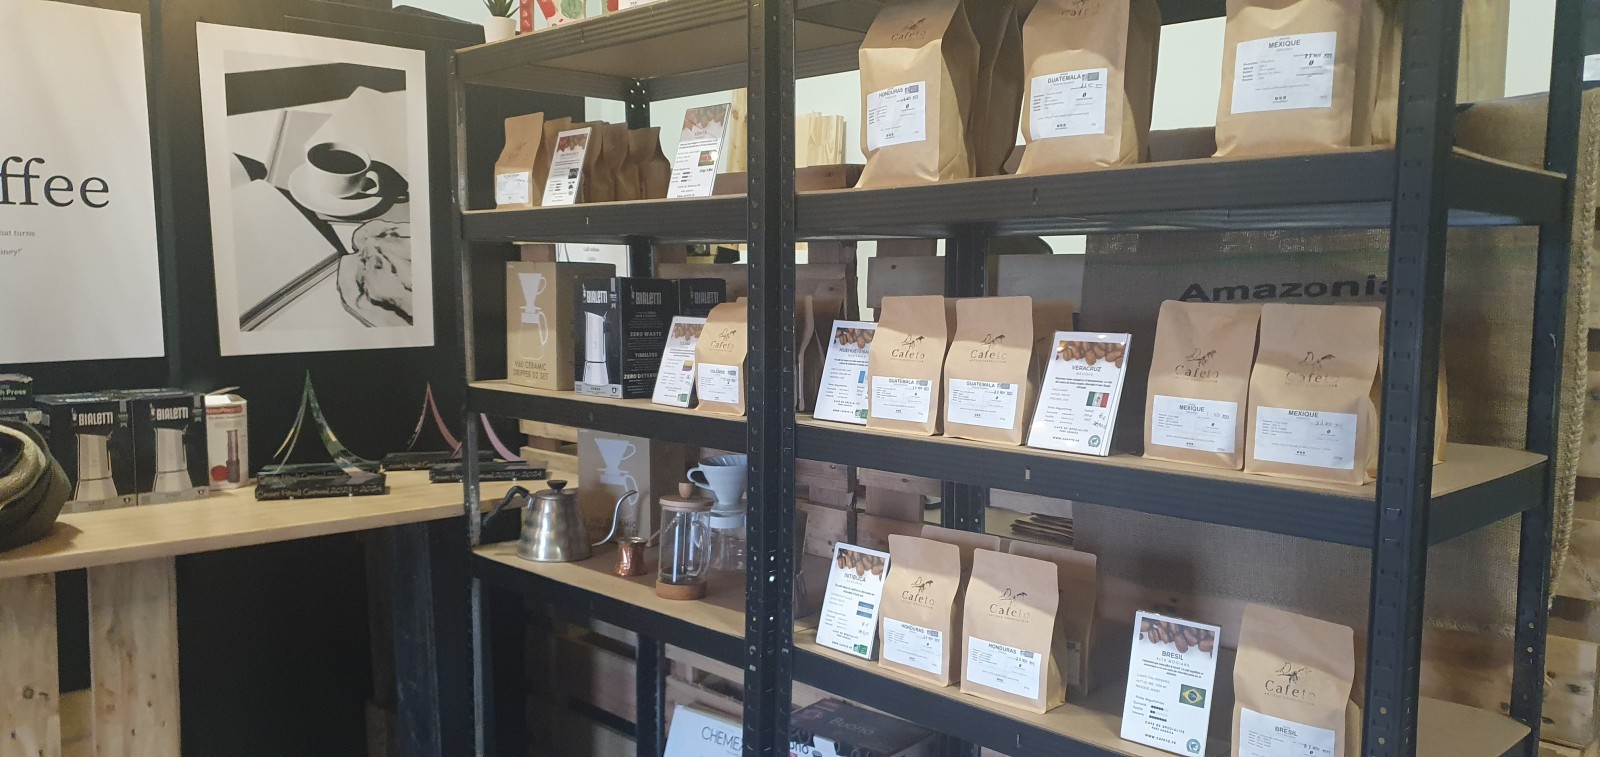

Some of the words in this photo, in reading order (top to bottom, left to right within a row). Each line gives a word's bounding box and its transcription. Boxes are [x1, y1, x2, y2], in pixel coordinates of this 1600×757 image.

[1268, 39, 1301, 49] MEXIQUE
[1047, 74, 1081, 84] GUATEMALA
[879, 88, 904, 98] HONDURAS
[587, 290, 608, 304] BIALETTI
[635, 292, 662, 305] BIALETTI
[891, 348, 926, 359] Cafeto
[525, 361, 547, 370] CERAMIC
[1174, 364, 1219, 379] Cafeto
[513, 369, 531, 377] DRIPPER
[540, 372, 549, 380] SET
[156, 406, 189, 421] BIALETTI
[1179, 404, 1205, 412] MEXIQUE
[1288, 410, 1319, 418] MEXIQUE
[78, 411, 114, 427] BIALETTI
[902, 590, 935, 606] Cafeto
[989, 603, 1030, 619] Cafeto
[901, 624, 924, 634] HONDURAS
[988, 642, 1017, 655] HONDURAS
[1161, 650, 1184, 661] BRESIL
[1264, 679, 1316, 699] Cafeto
[1274, 725, 1298, 737] BRESIL
[701, 726, 743, 752] CHEME
